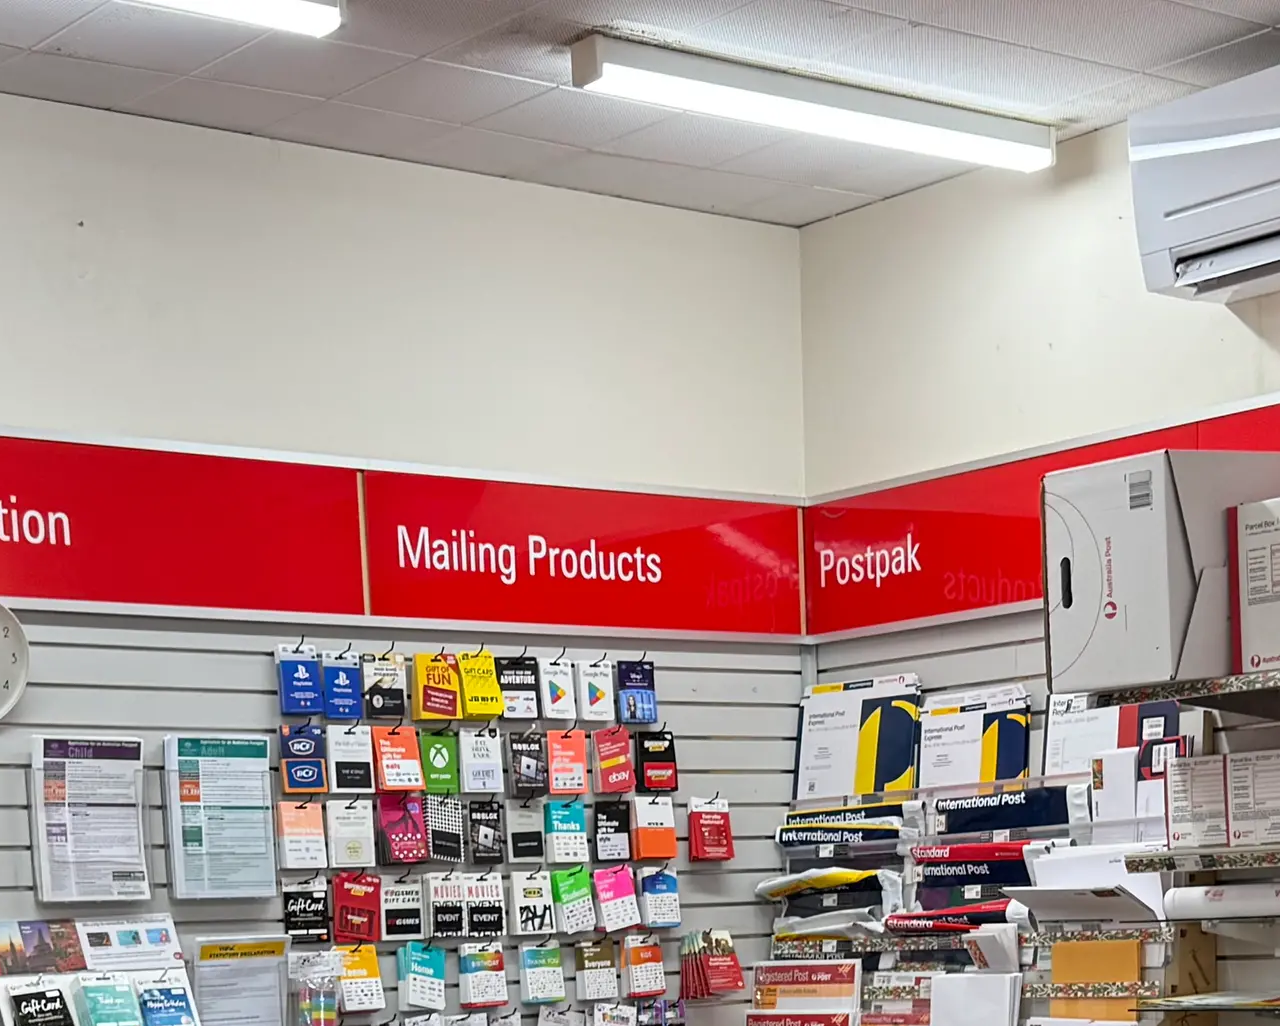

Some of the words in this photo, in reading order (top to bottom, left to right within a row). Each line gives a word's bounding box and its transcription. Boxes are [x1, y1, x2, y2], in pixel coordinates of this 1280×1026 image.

[1246, 523, 1263, 531] Parcel
[396, 525, 518, 585] Mailing
[528, 535, 662, 583] Products
[819, 532, 921, 592] Postpak
[3, 627, 9, 638] 2
[12, 653, 17, 664] 3
[3, 680, 9, 690] 4
[427, 674, 451, 685] FUN
[501, 675, 535, 684] ADVENTURE
[69, 747, 93, 758] Child
[609, 771, 629, 783] ebay
[938, 795, 1000, 810] International
[1002, 792, 1025, 805] Post
[553, 821, 580, 831] Thanks
[782, 831, 841, 842] International
[843, 831, 863, 842] Post
[434, 887, 461, 898] MOVIES
[468, 887, 500, 898] MOVIES
[600, 891, 614, 900] Her
[438, 914, 459, 922] EVENT
[473, 914, 498, 922] EVENT
[411, 962, 433, 975] Home
[585, 960, 611, 968] Everyone
[757, 970, 792, 983] Registered
[794, 970, 808, 981] Post
